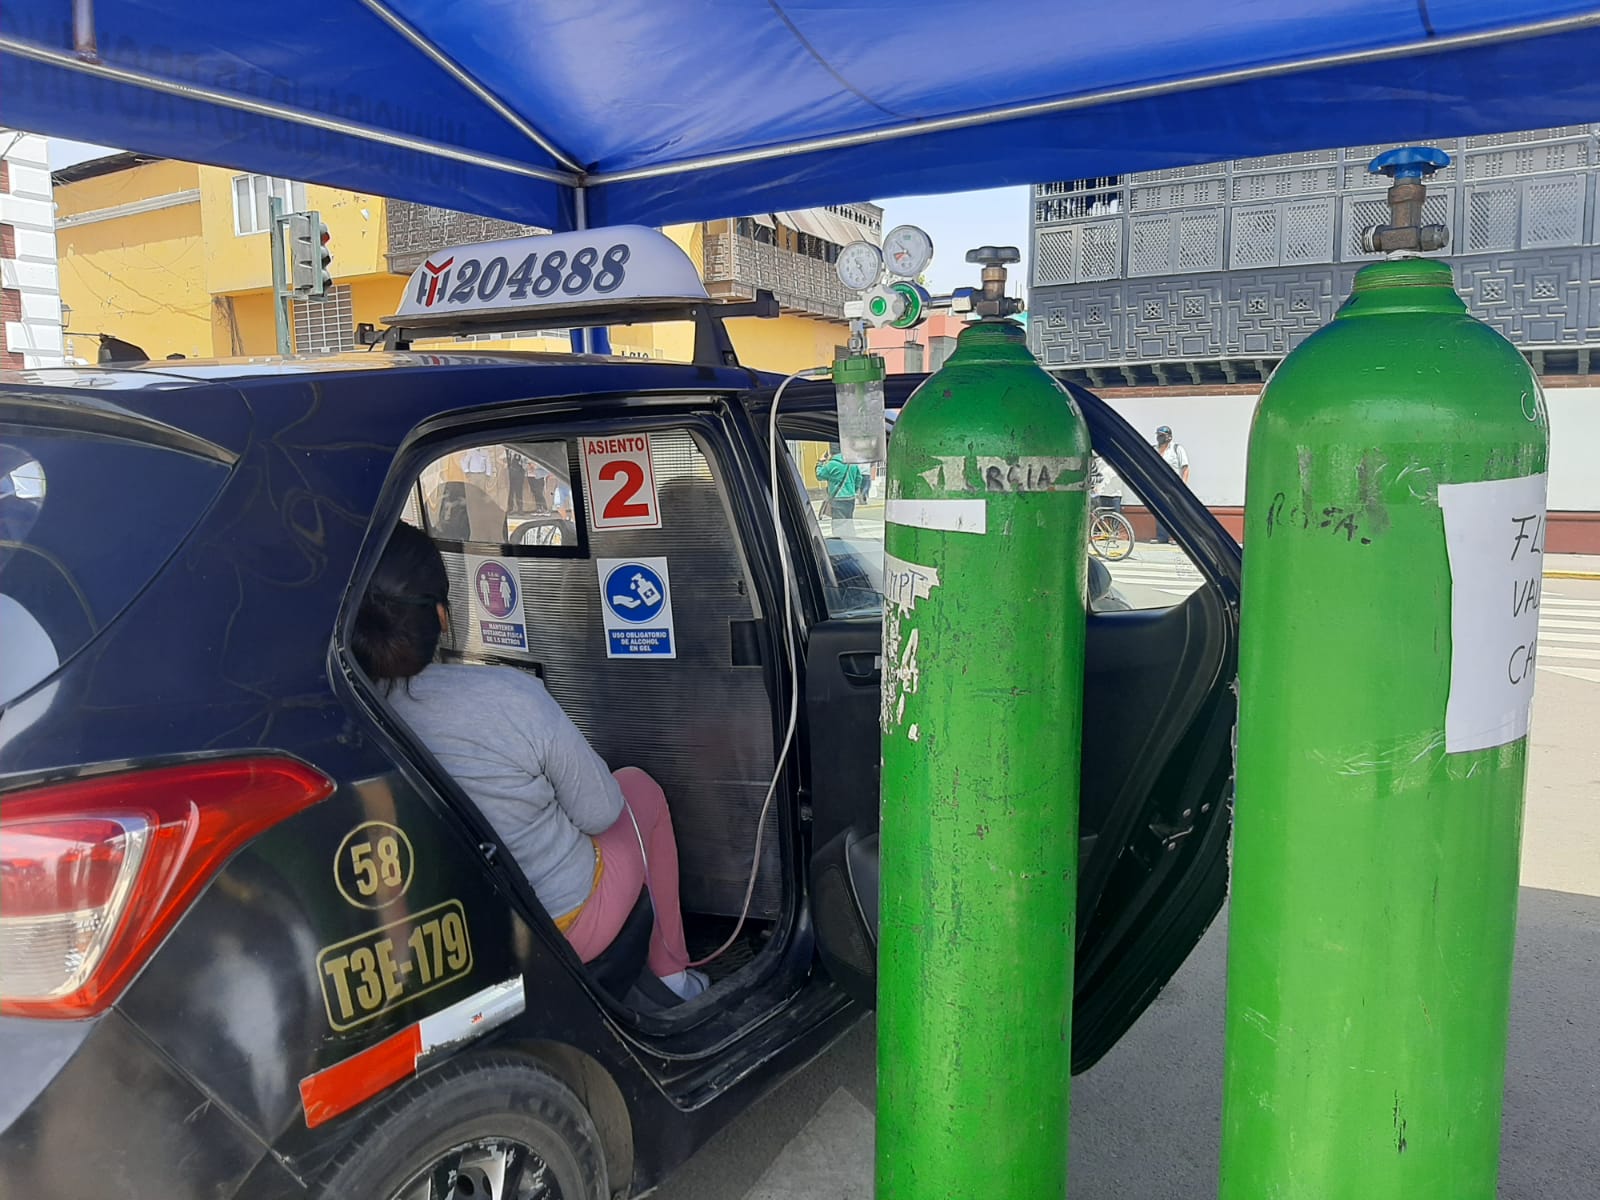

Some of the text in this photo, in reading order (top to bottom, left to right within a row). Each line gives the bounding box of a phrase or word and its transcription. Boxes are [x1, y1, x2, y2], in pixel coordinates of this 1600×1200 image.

[448, 243, 631, 305] 204888
[587, 437, 645, 456] ASIENTO
[598, 459, 651, 520] 2
[1510, 514, 1543, 561] FL
[626, 631, 667, 639] OBLIGATORIO
[630, 638, 660, 646] ALCOHOL
[350, 835, 402, 896] 58
[323, 912, 468, 1020] T3E-179
